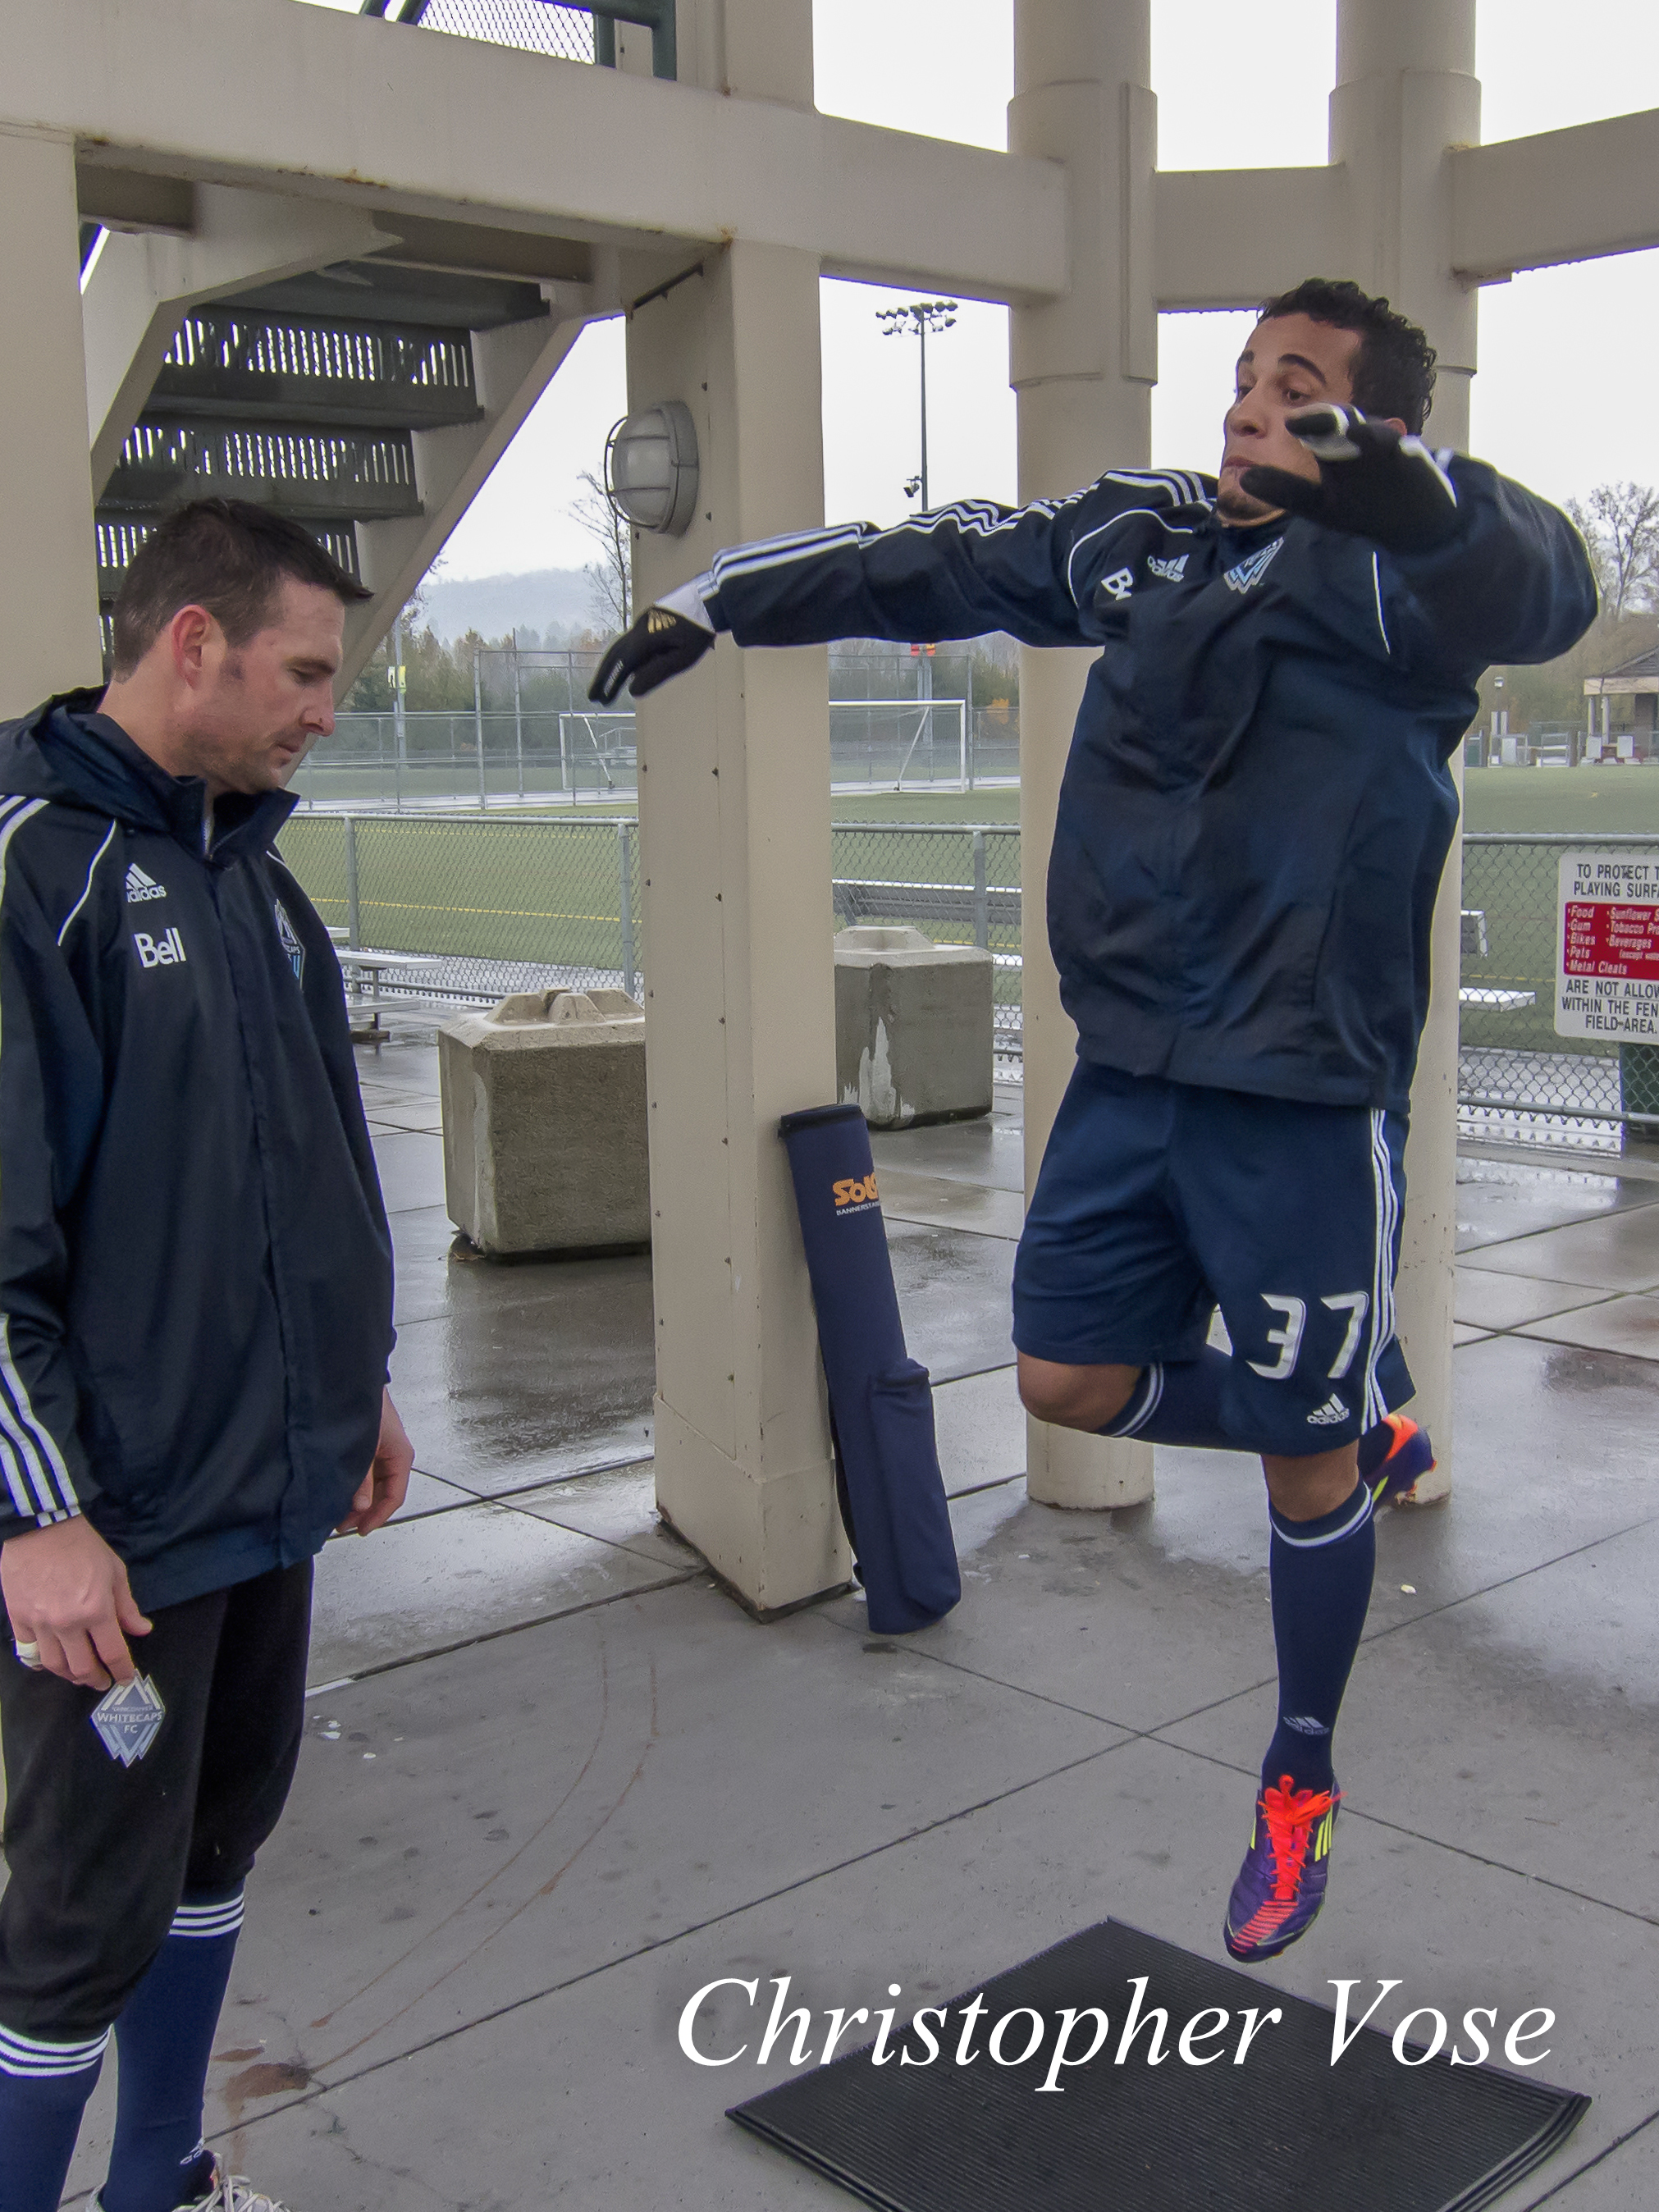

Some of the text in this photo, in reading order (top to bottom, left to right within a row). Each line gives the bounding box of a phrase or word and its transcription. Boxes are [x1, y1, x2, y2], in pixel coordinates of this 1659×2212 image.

[1576, 863, 1592, 879] TO
[1597, 864, 1650, 880] PROTECT
[1574, 880, 1620, 897] PLAYING
[1570, 904, 1595, 918] Food
[1570, 918, 1591, 932] Gum
[1570, 931, 1596, 945] Bikes
[133, 927, 187, 968] Bell
[1569, 958, 1629, 976] Metal Cleats
[1565, 979, 1589, 994] ARE
[1595, 980, 1620, 996] NOT
[1562, 996, 1602, 1013] WITHIN
[1608, 999, 1630, 1016] THE
[1585, 1014, 1658, 1035] FIELD AREA.
[1245, 1291, 1370, 1379] 37
[97, 1711, 163, 1723] WHITECAPS
[124, 1724, 139, 1734] FC
